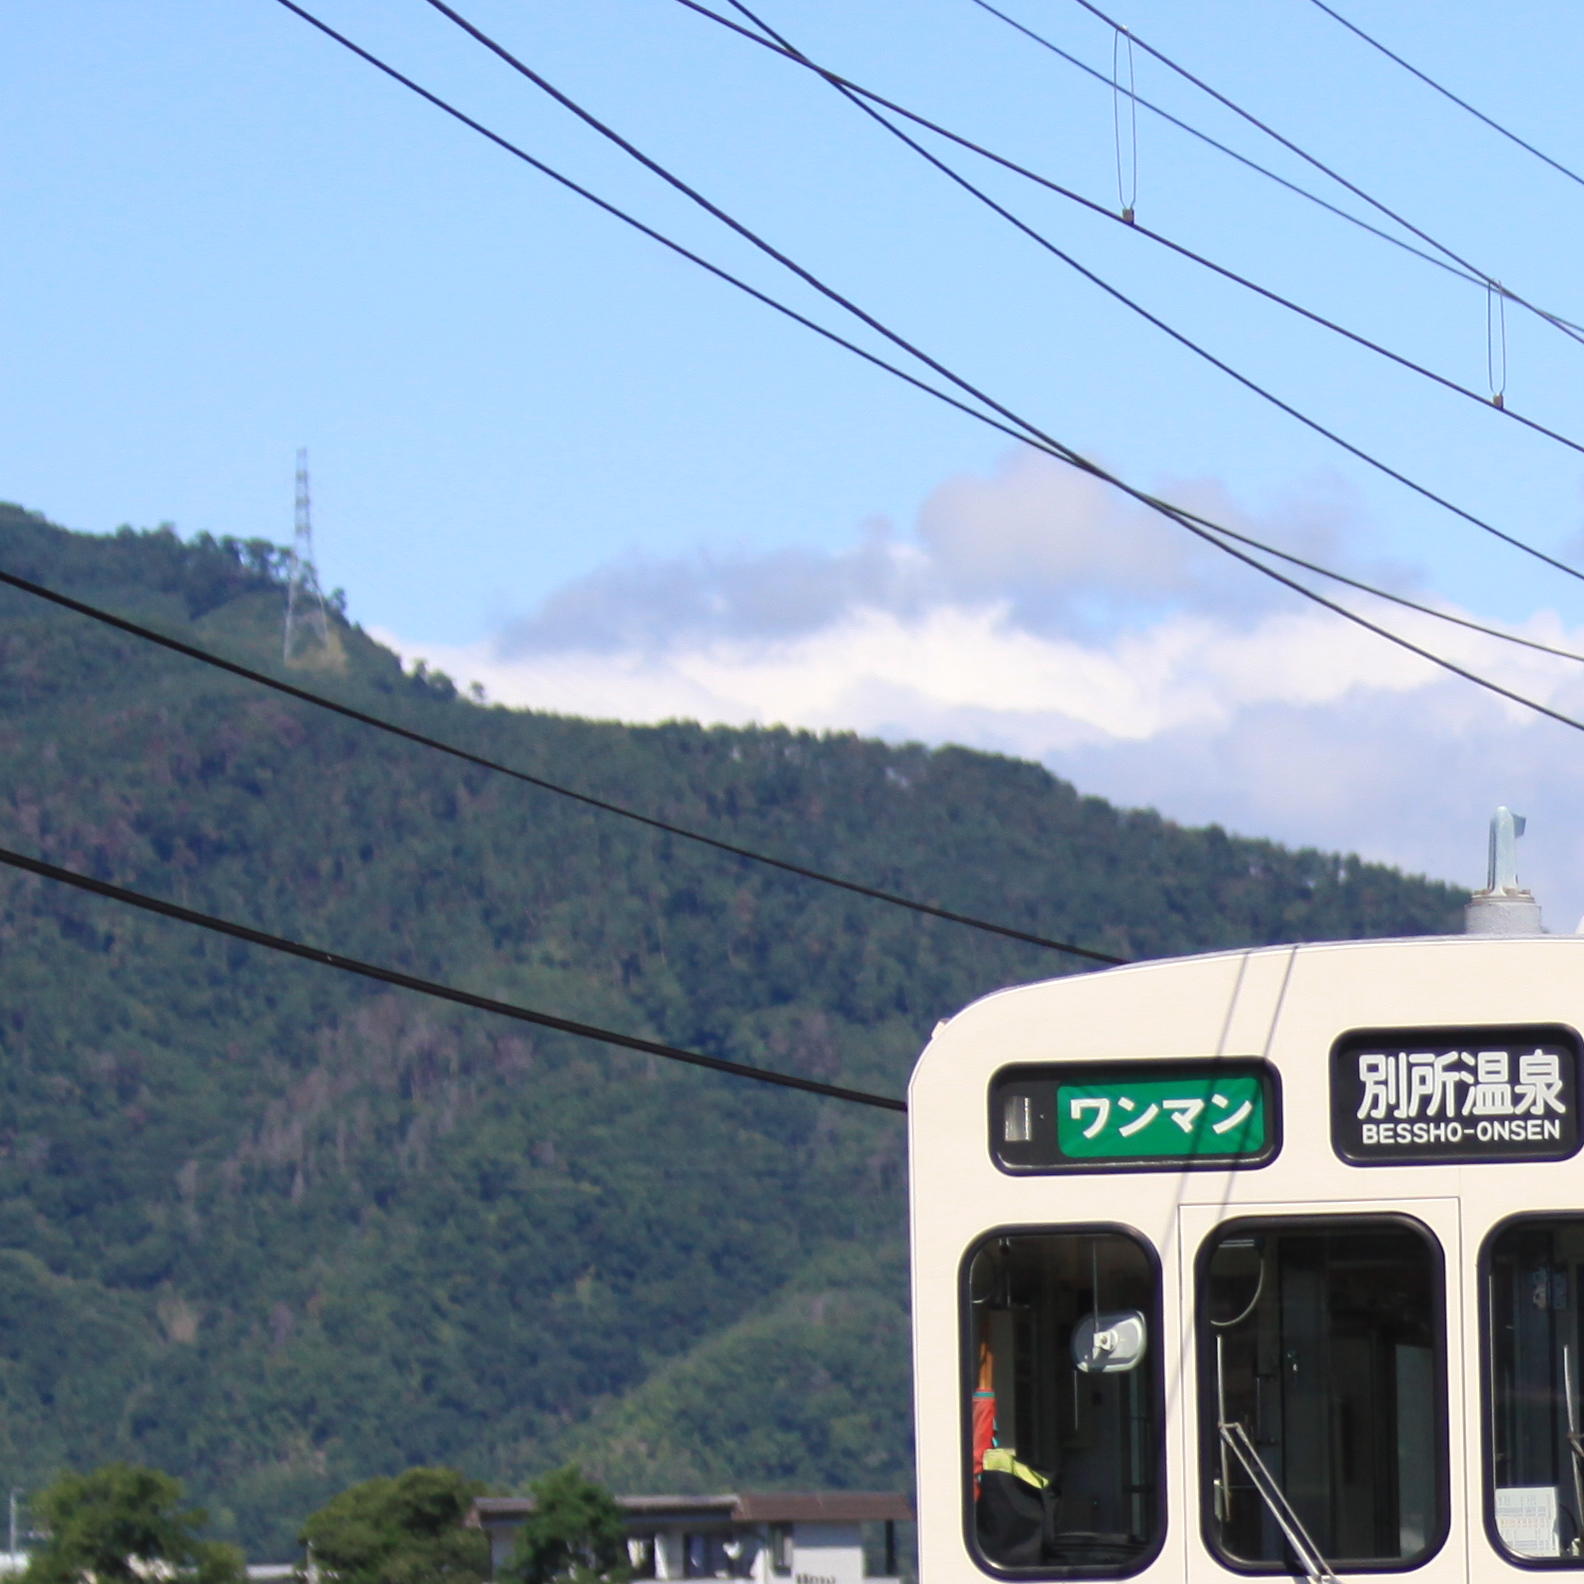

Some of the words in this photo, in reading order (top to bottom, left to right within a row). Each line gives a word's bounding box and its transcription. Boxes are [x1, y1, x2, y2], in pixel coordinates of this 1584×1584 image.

[1356, 1048, 1567, 1120] 別所温泉
[1069, 1093, 1254, 1139] ワンマン
[1361, 1119, 1561, 1145] BESSHO-ONSEN
